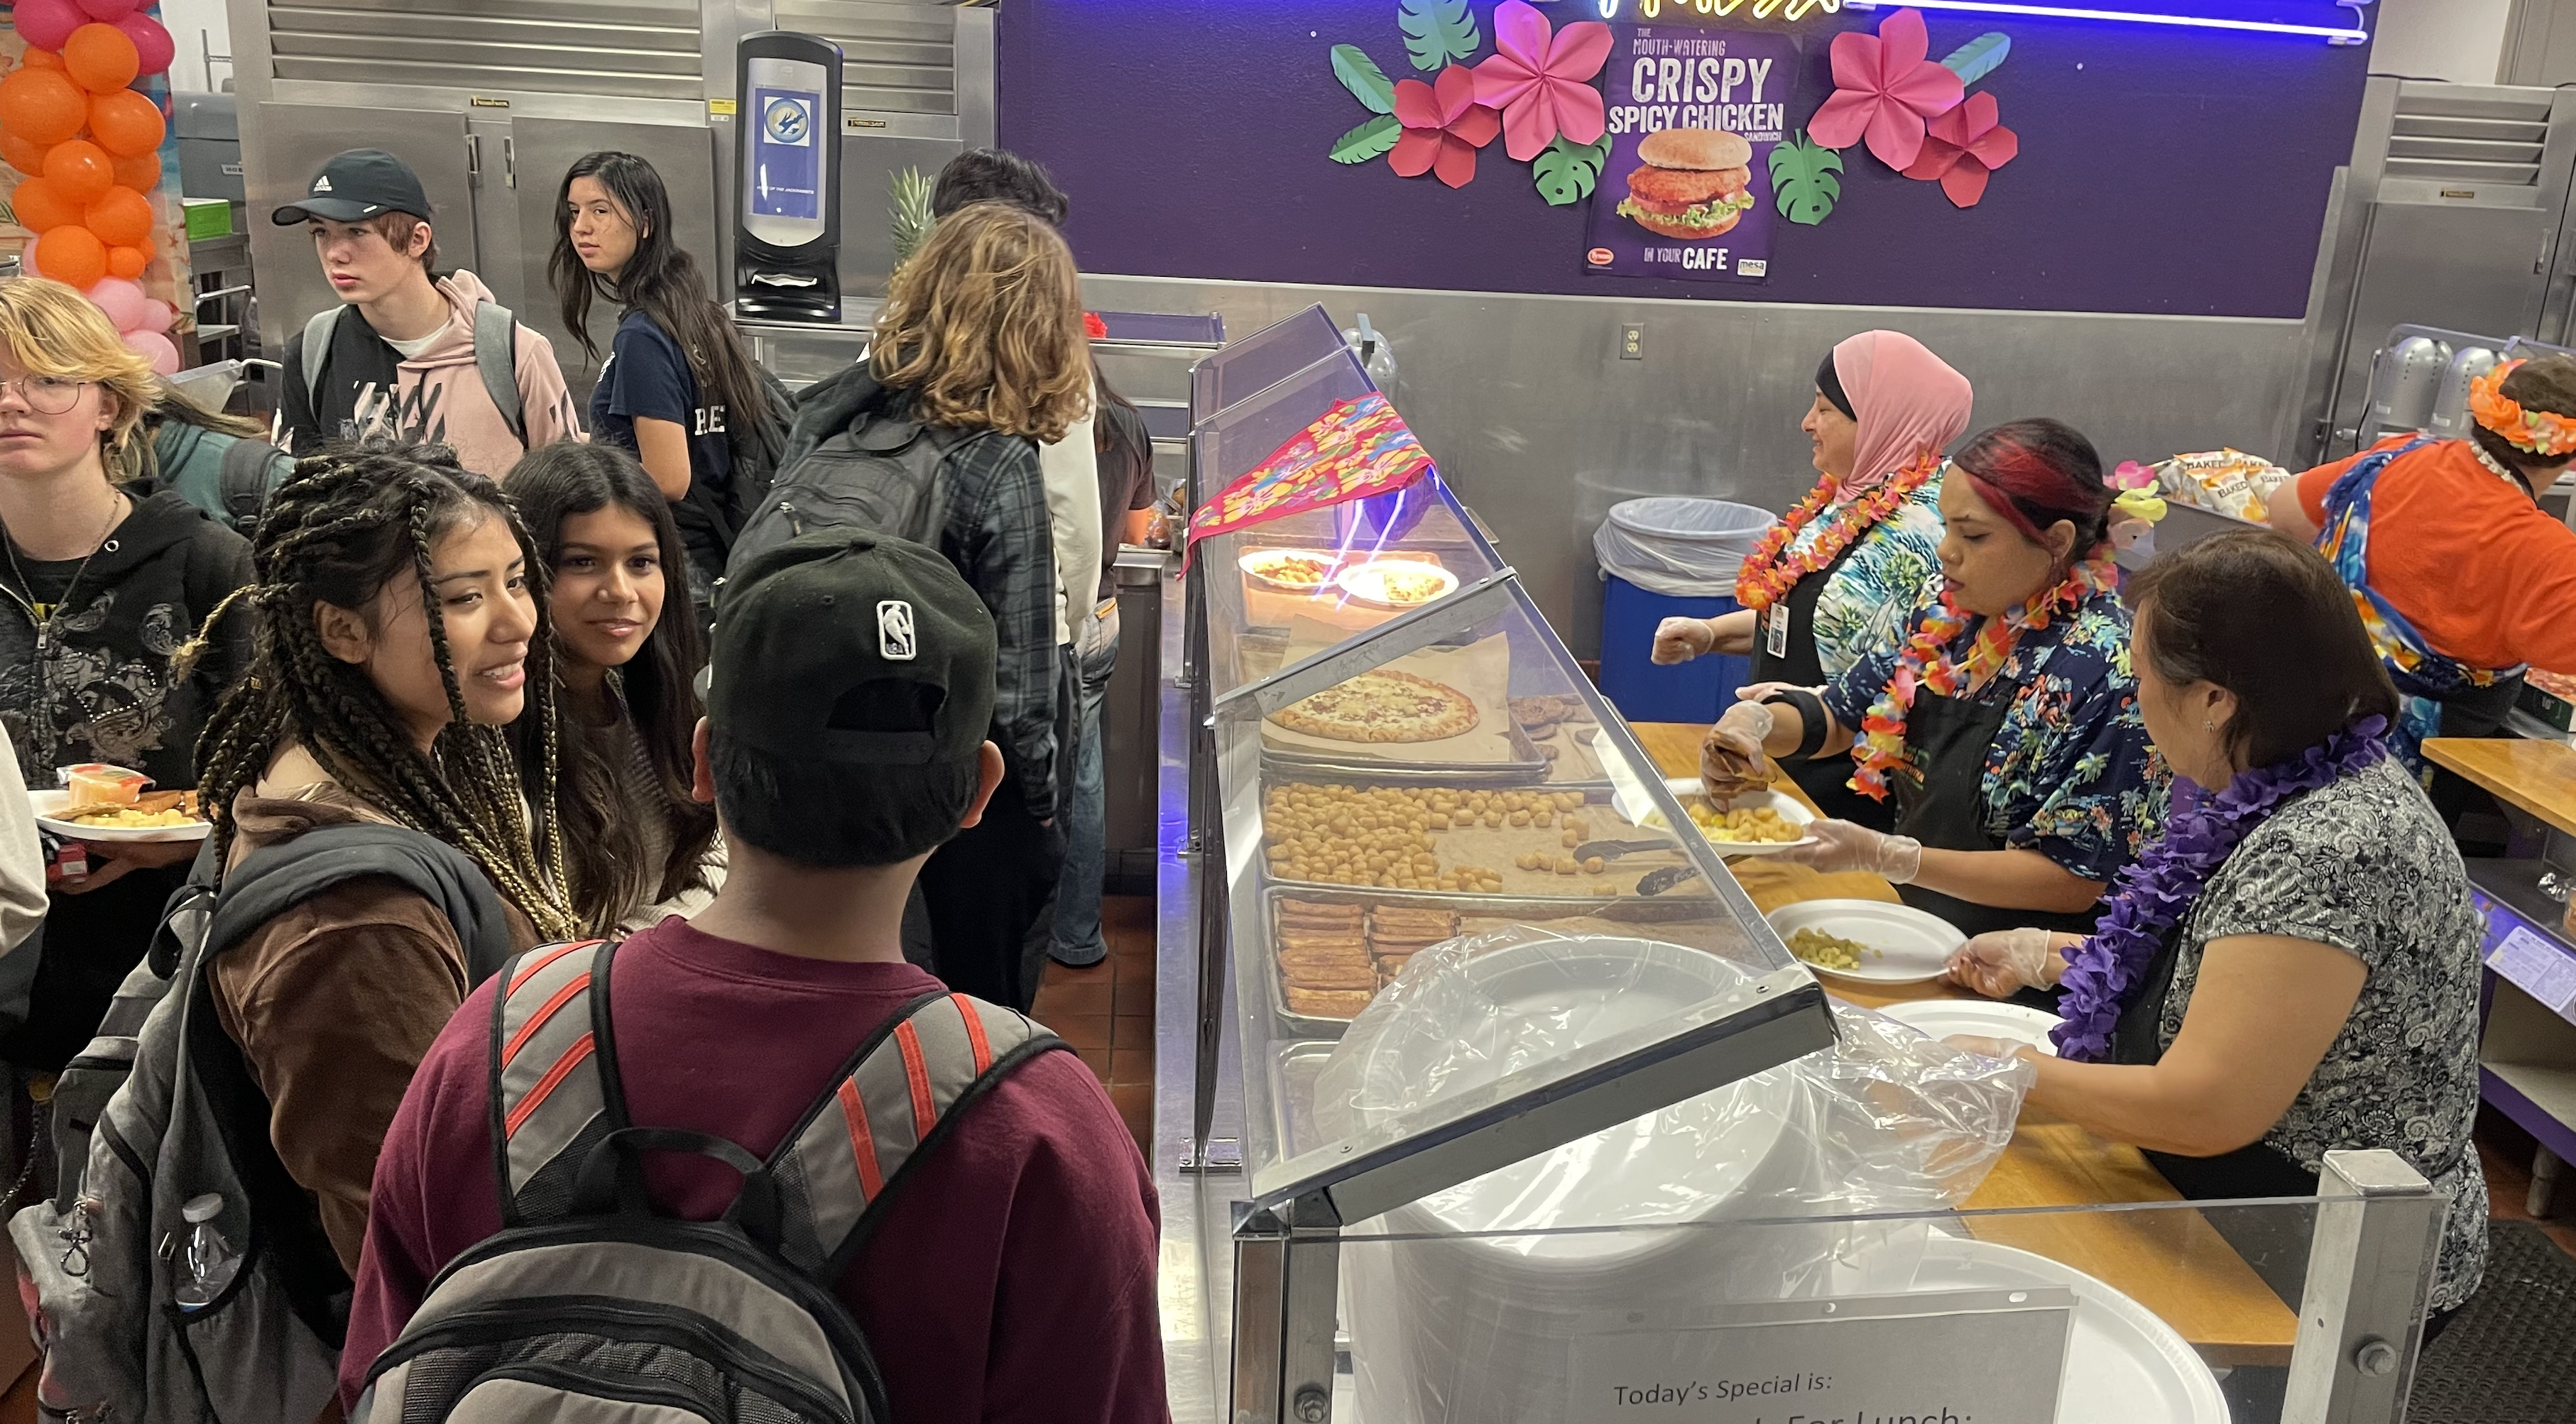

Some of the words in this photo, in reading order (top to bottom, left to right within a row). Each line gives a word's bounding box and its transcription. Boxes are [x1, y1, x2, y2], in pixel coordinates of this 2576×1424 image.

[1637, 28, 1652, 38] THE
[1633, 39, 1727, 57] MOUTH-WATERING
[1632, 57, 1773, 103] CRISPY
[1608, 105, 1679, 134] SPICY
[1682, 104, 1784, 131] CHICKEN
[1744, 131, 1782, 143] SANDWICH
[1644, 247, 1654, 263] IN
[1657, 247, 1681, 263] YOUR
[1682, 246, 1729, 270] CAFE
[1740, 261, 1764, 270] mesa
[2217, 481, 2248, 498] BAKED
[1614, 1381, 1708, 1406] Today's
[1715, 1373, 1799, 1402] Special
[1808, 1372, 1833, 1391] is:
